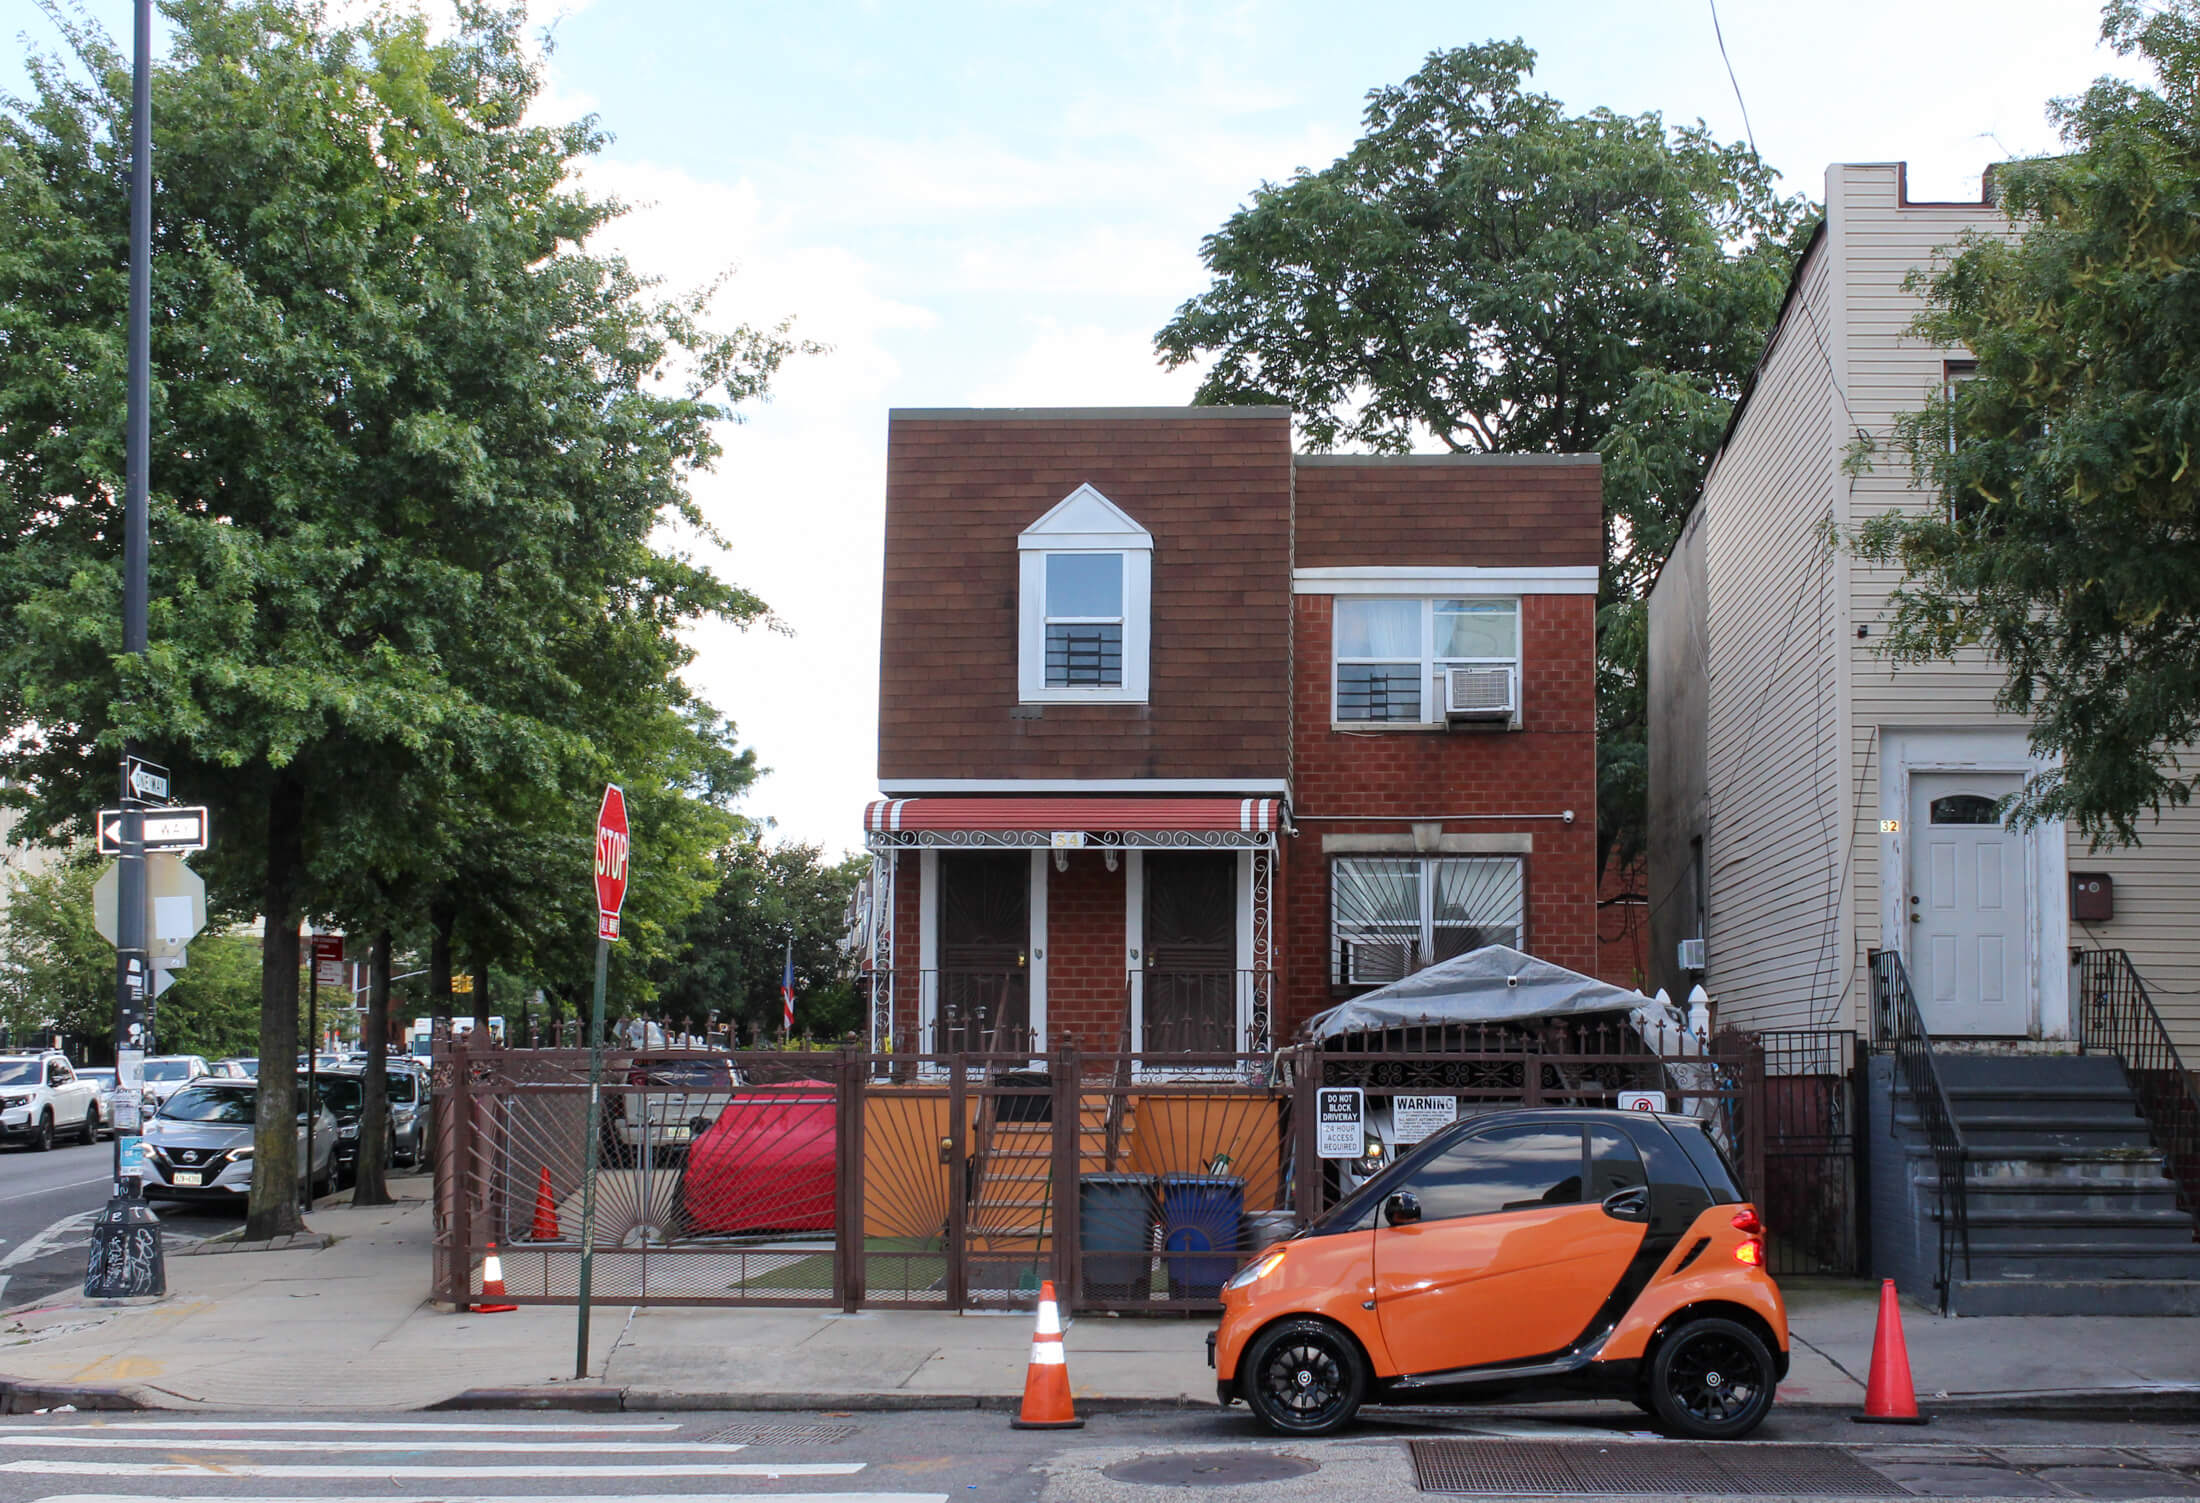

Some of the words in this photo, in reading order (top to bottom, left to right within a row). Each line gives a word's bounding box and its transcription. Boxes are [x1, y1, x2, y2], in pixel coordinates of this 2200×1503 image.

[136, 772, 149, 790] ONE
[150, 777, 165, 795] WAY
[1882, 820, 1897, 831] 32
[598, 827, 627, 881] STOP
[1327, 1094, 1338, 1103] DO
[1339, 1094, 1352, 1103] NOT
[1328, 1103, 1352, 1112] BLOCK
[1397, 1098, 1453, 1110] WARNING
[1322, 1113, 1358, 1121] DRIVEWAY
[1327, 1134, 1354, 1142] ACCESS
[1323, 1143, 1357, 1151] REQUIRED
